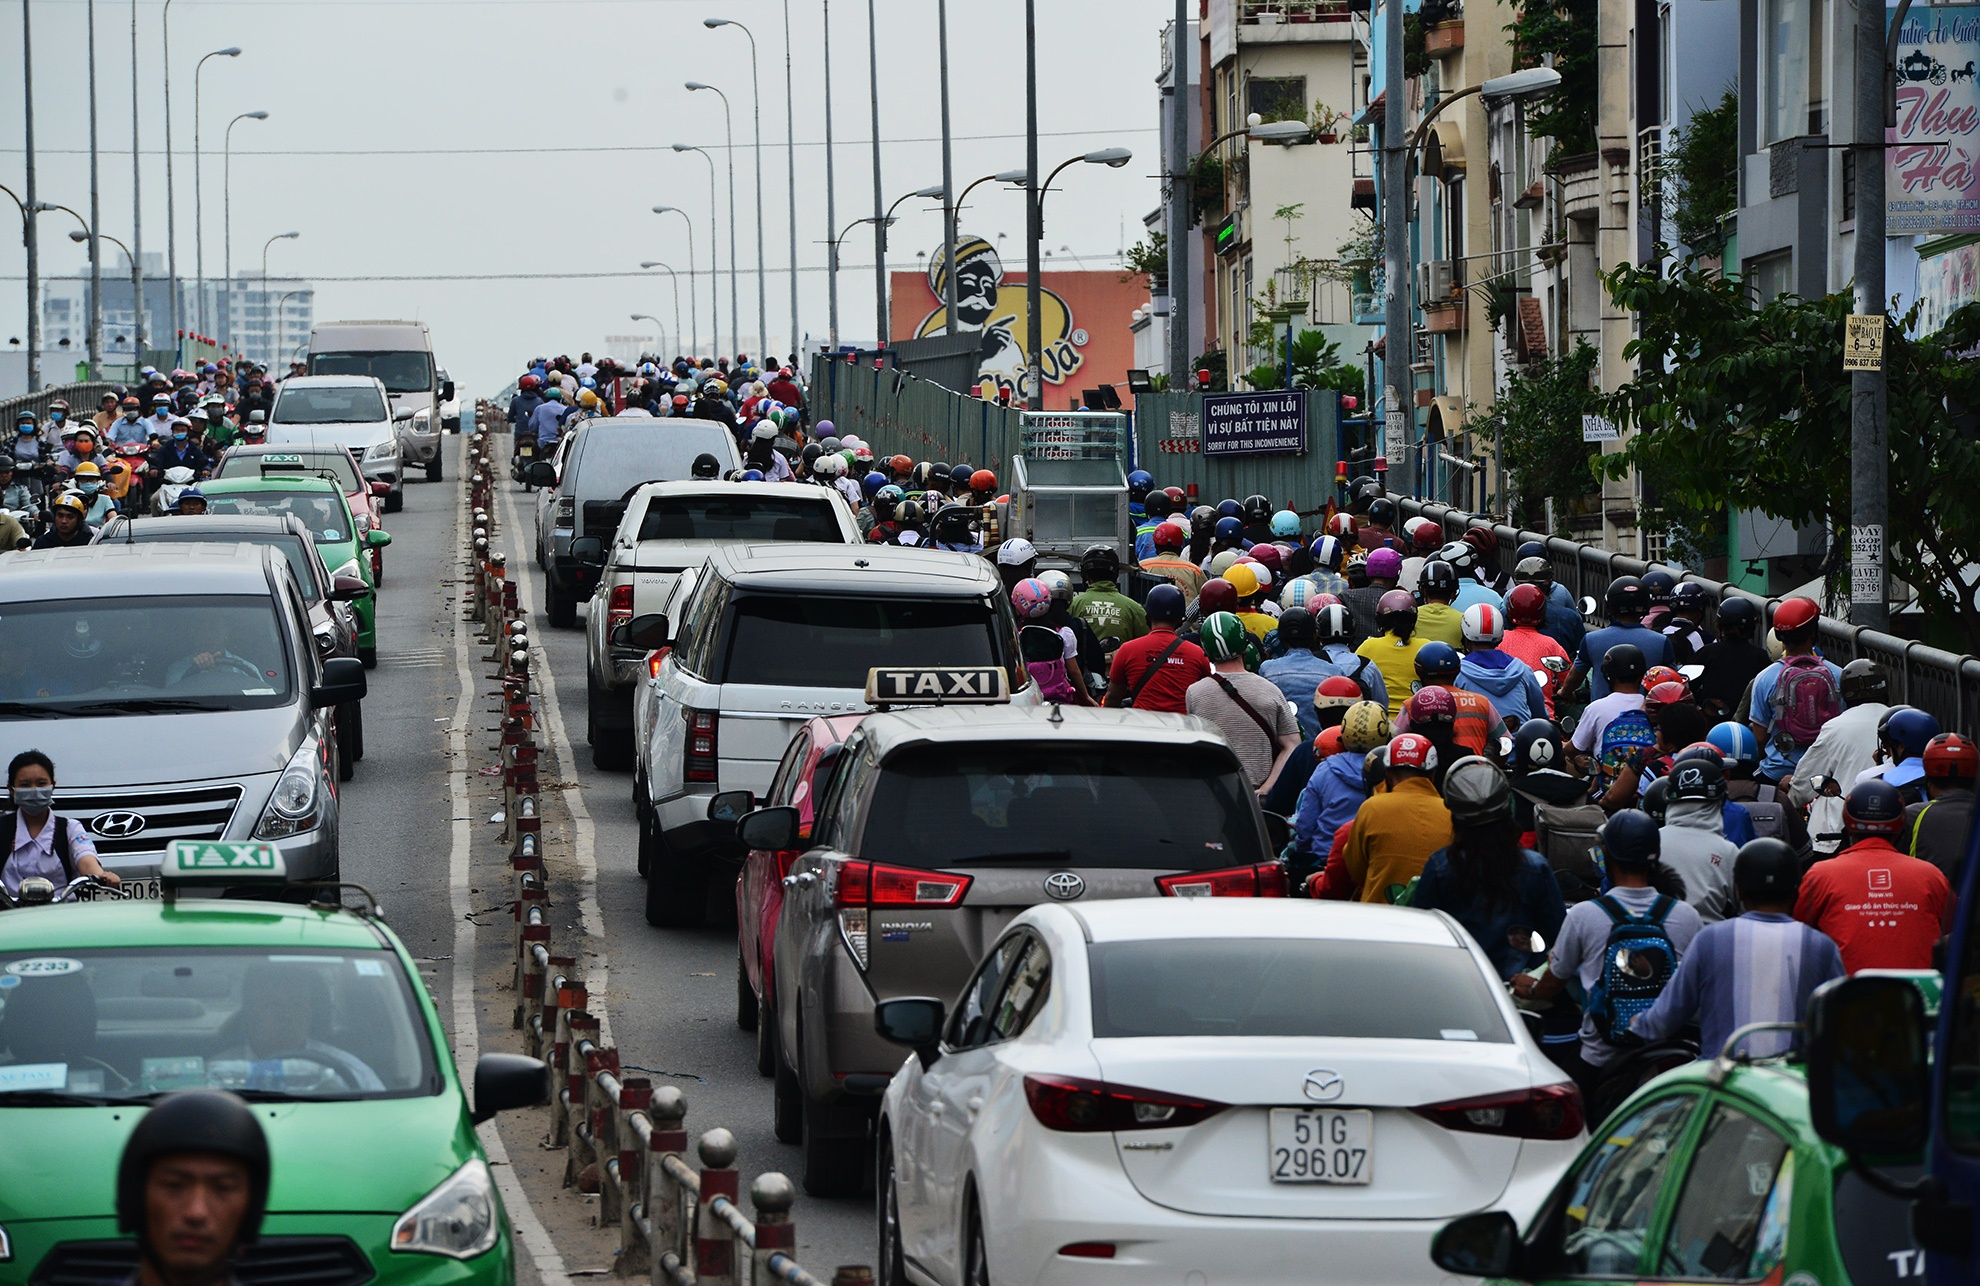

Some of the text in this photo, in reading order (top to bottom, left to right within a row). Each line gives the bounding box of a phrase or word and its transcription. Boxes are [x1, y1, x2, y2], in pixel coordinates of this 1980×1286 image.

[1896, 87, 1978, 137] Thu
[1895, 145, 1975, 193] Hà
[1211, 396, 1296, 417] CHÚNG TÔI XIN LỖI
[1208, 420, 1217, 434] VÌ
[1220, 420, 1233, 436] SỰ
[1235, 417, 1252, 433] BẤT
[1255, 417, 1278, 434] TIỆN
[1280, 415, 1299, 430] NÀY
[1207, 437, 1299, 451] SORRY FOR THIS INCONVENIENCE
[1860, 528, 1880, 536] VAY
[1085, 604, 1121, 616] VINTAGE
[886, 672, 990, 695] TAXI
[781, 700, 856, 711] RANGE
[18, 961, 70, 972] 2233
[1295, 1115, 1346, 1145] 51G
[1275, 1148, 1367, 1179] 296.07
